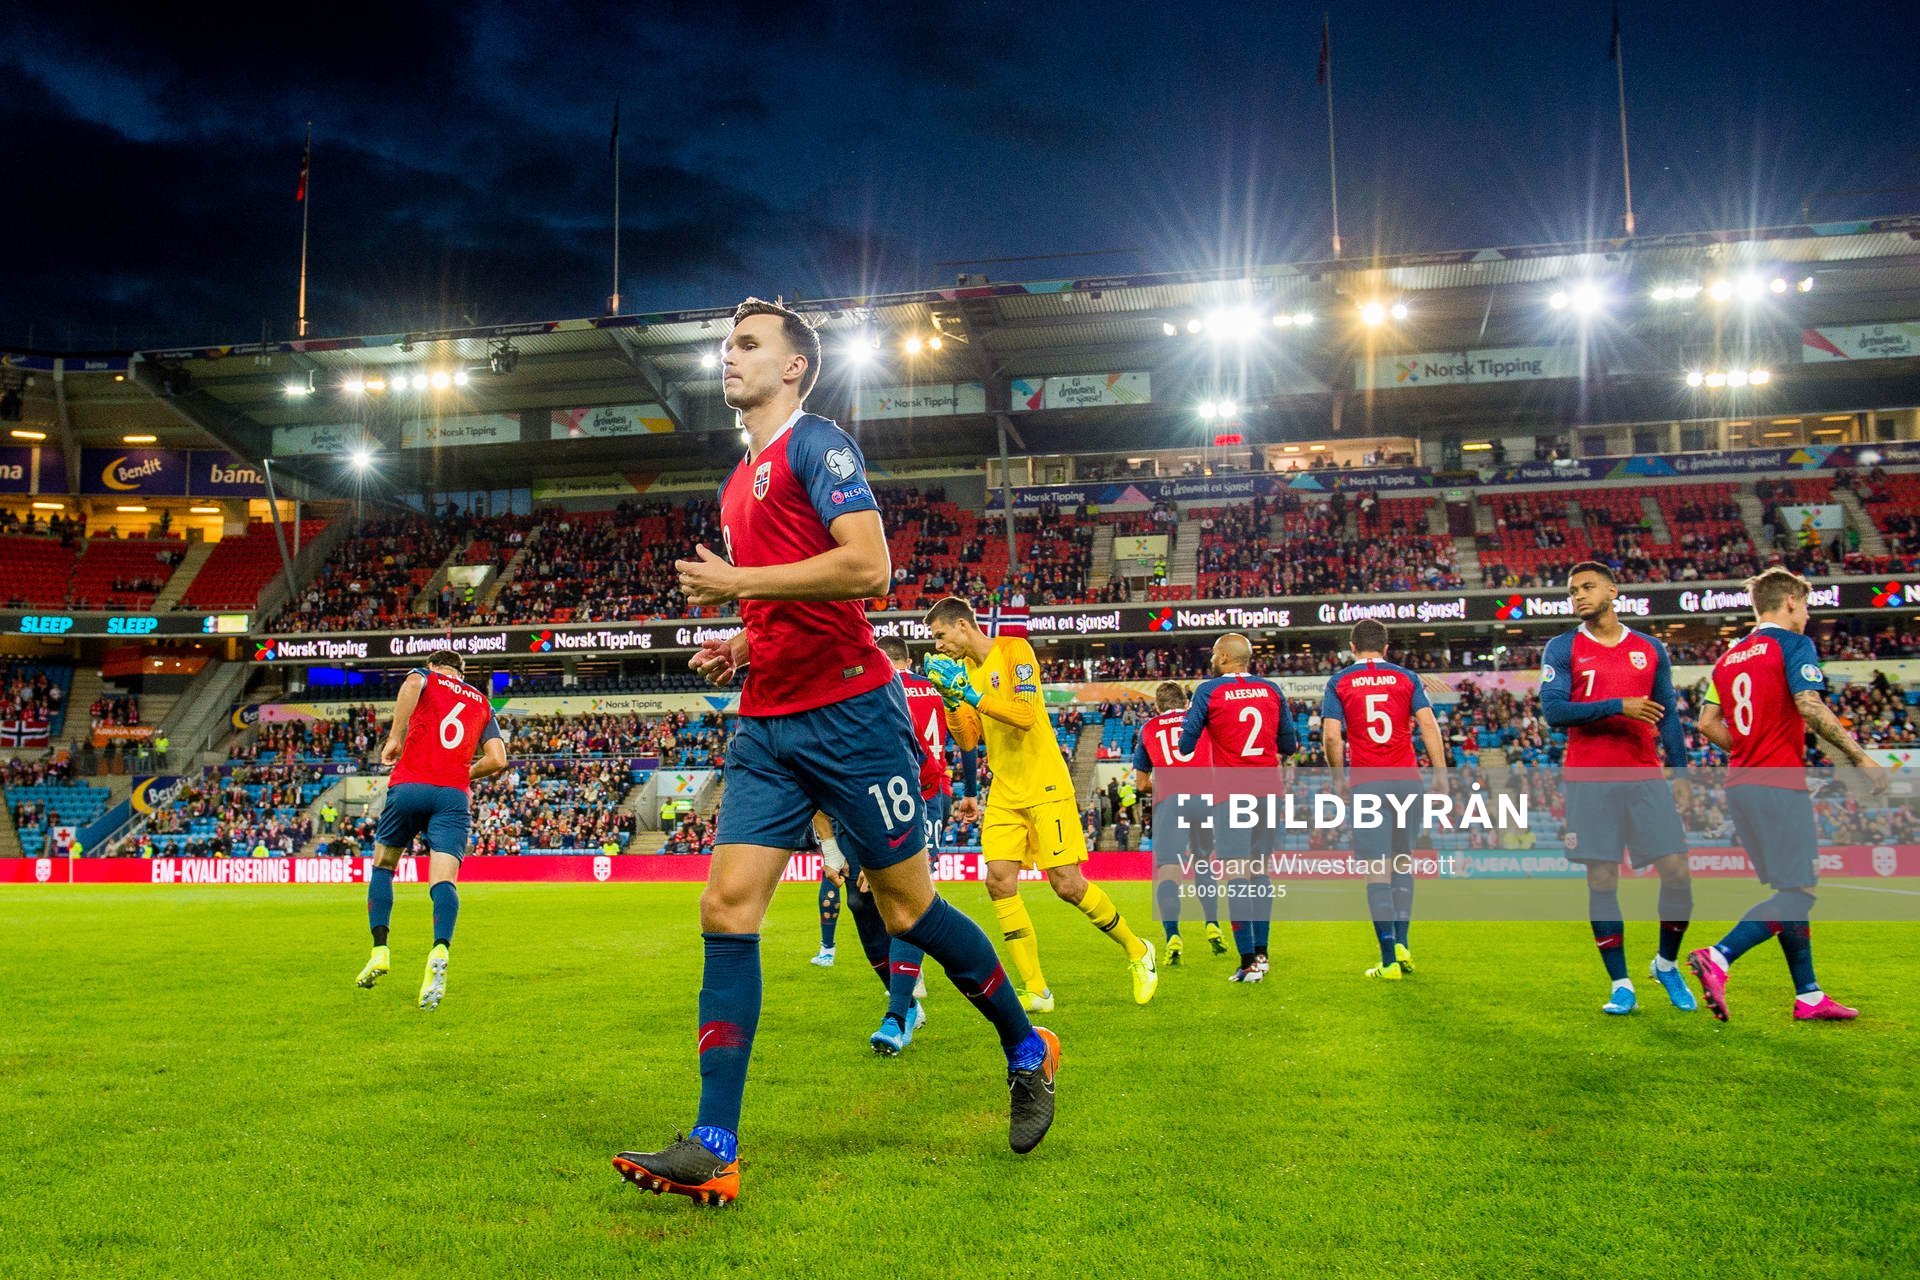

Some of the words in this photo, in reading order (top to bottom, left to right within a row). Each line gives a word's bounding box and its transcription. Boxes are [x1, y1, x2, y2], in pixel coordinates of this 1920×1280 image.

[1425, 360, 1474, 378] Norsk
[1478, 358, 1544, 376] Tipping
[895, 398, 922, 408] Norsk
[924, 396, 959, 408] Tipping
[440, 427, 464, 437] Norsk
[466, 424, 497, 437] Tipping
[117, 458, 162, 482] Bendit
[1350, 476, 1379, 487] Norsk
[1380, 473, 1416, 486] Tipping
[1024, 494, 1050, 504] Norsk
[1051, 491, 1085, 503] Tipping
[1319, 604, 1336, 623] Gi
[1338, 603, 1397, 622] drømmen
[1397, 604, 1416, 620] en
[1417, 598, 1466, 622] sjanse!
[1680, 591, 1699, 612] Gi
[21, 616, 74, 634] SLEEP
[107, 617, 158, 634] SLEEP
[1058, 616, 1075, 631] en
[1076, 611, 1120, 634] sjanse!
[1177, 610, 1226, 627] Norsk
[1226, 607, 1290, 628] Tipping
[391, 637, 404, 655] Gi
[406, 636, 452, 655] drømmen
[453, 638, 467, 651] en
[468, 633, 507, 654] sjanse!
[555, 633, 598, 649] Norsk
[597, 630, 653, 650] Tipping
[677, 628, 691, 646] Gi
[278, 641, 318, 657] Norsk
[318, 640, 369, 659] Tipping
[1352, 675, 1397, 688] HOVLAND
[1582, 670, 1596, 697] 7
[606, 701, 629, 710] Norsk
[632, 698, 662, 710] Tipping
[1225, 689, 1268, 701] ALEESAMI
[1732, 672, 1753, 736] 8
[243, 711, 259, 723] Ben
[440, 702, 466, 749] 6
[1365, 694, 1392, 744] 5
[1238, 707, 1265, 757] 2
[1156, 727, 1196, 766] 15
[868, 776, 915, 831] 18
[1055, 819, 1064, 844] 1
[151, 858, 290, 883] EM-KVALIFISERING
[1475, 857, 1521, 872] UEFA
[1521, 856, 1569, 873] EURO
